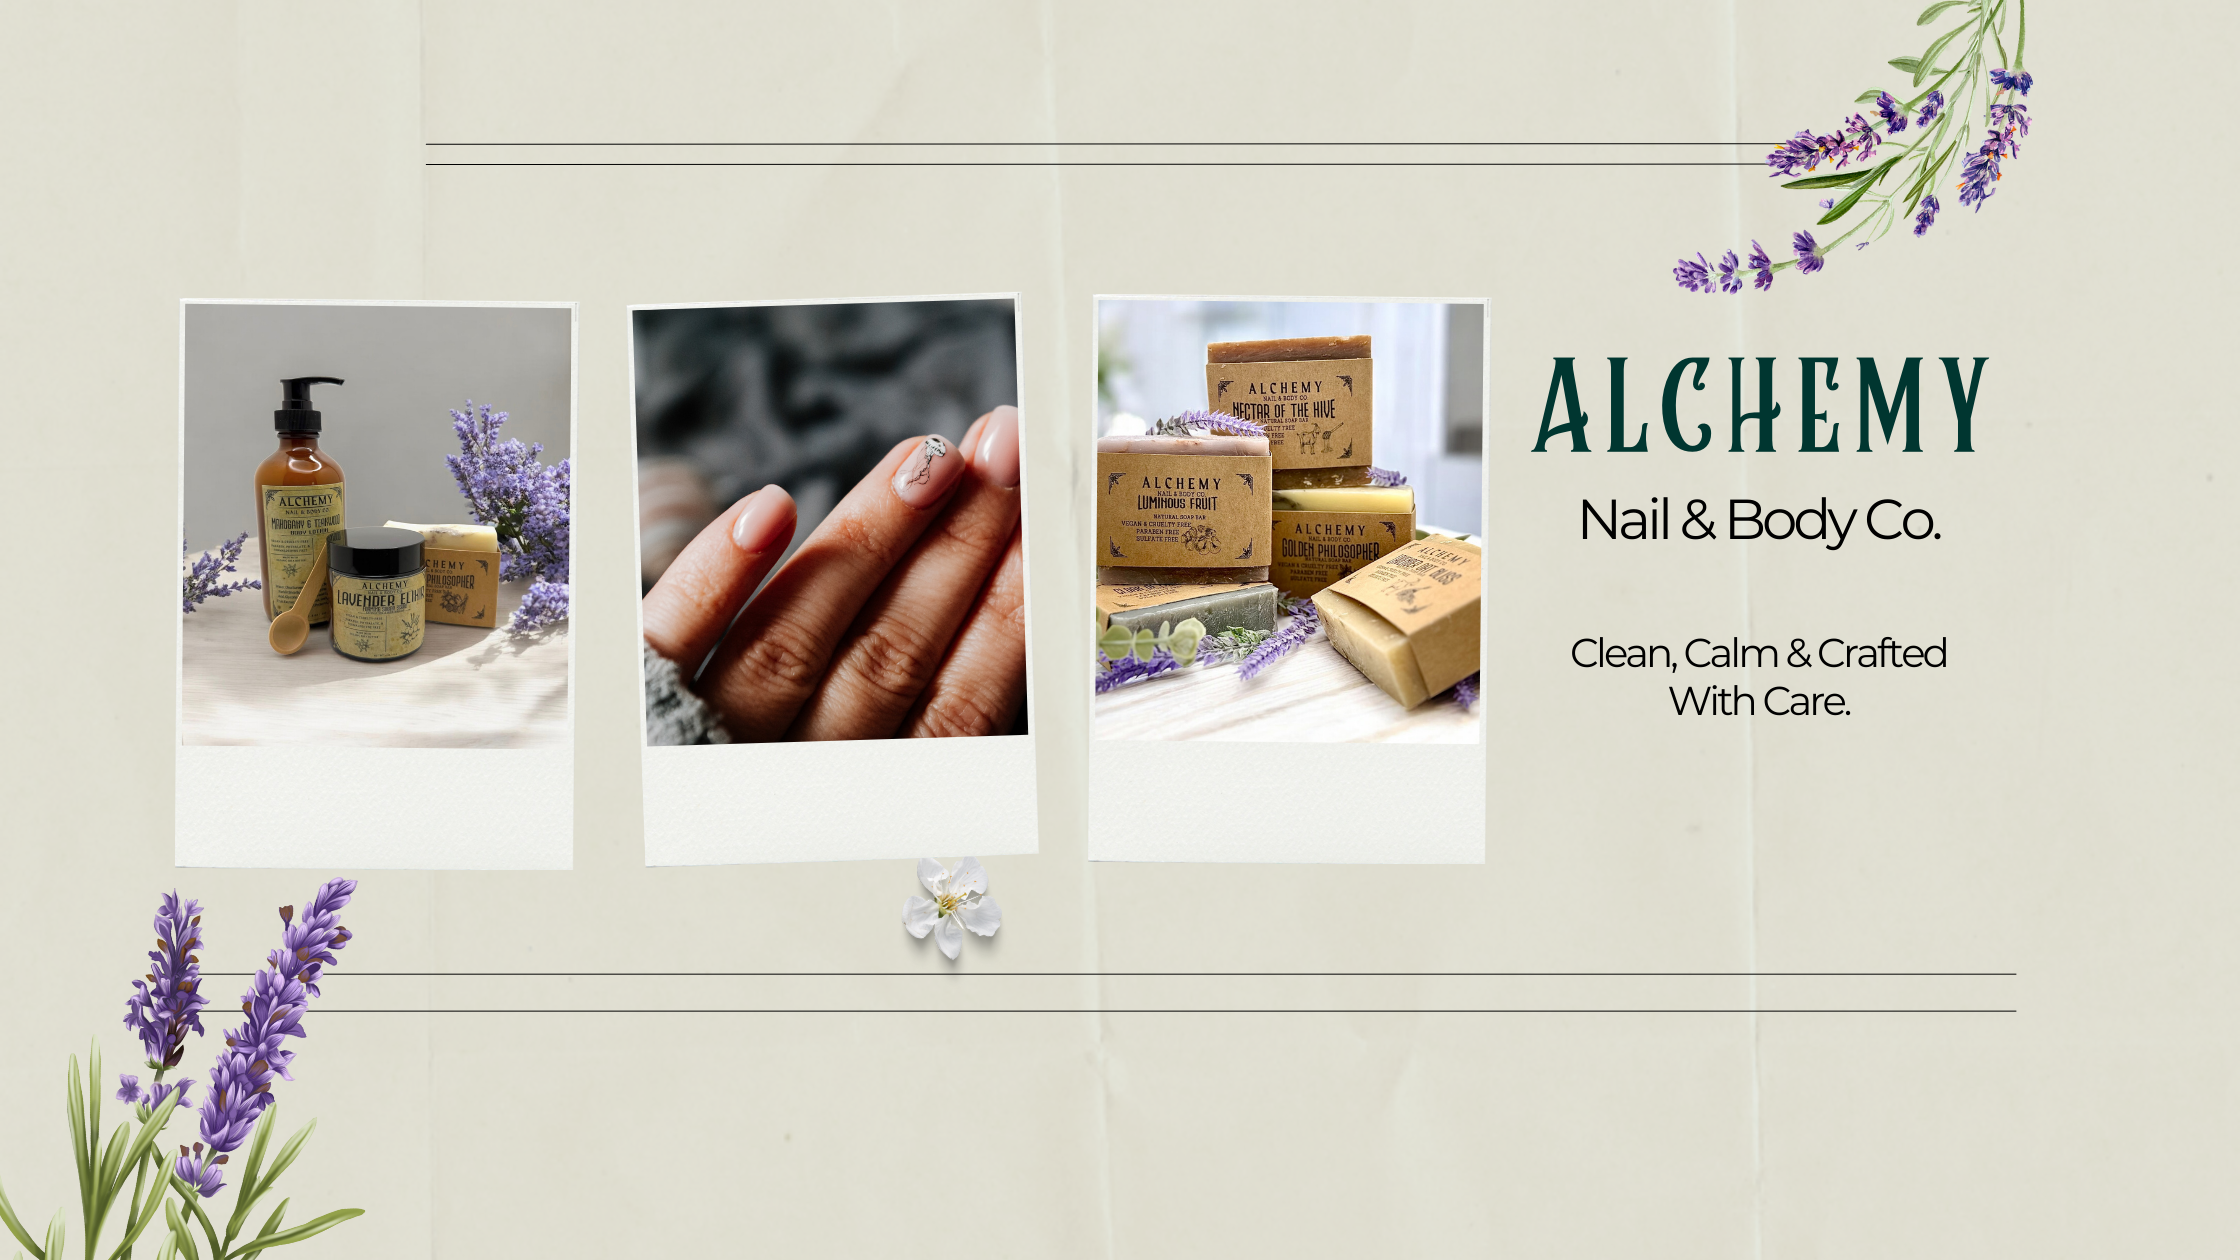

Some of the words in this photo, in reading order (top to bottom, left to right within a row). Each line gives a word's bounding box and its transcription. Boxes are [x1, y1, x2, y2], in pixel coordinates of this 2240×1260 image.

[1249, 381, 1322, 394] ALCHEMY
[1233, 402, 1270, 420] NECTAR
[1275, 404, 1285, 418] OF
[1291, 402, 1309, 417] THE
[1314, 399, 1335, 418] HIVE
[1142, 476, 1221, 490] ALCHEMY
[279, 495, 333, 506] ALCHEMY
[1138, 495, 1185, 510] LUMINOUS
[1190, 496, 1218, 511] FRUIT
[272, 518, 304, 530] MAHOGANY
[1295, 523, 1365, 536] ALCHEMY
[1282, 538, 1314, 557] GOLDEN
[1318, 542, 1380, 561] PHILOSOPHER
[1417, 547, 1470, 566] ALCHEMY
[426, 559, 464, 570] CHEMY
[362, 581, 408, 590] ALCHEMY
[427, 574, 474, 589] PHILOSOPHER
[338, 589, 395, 607] LAVENDER
